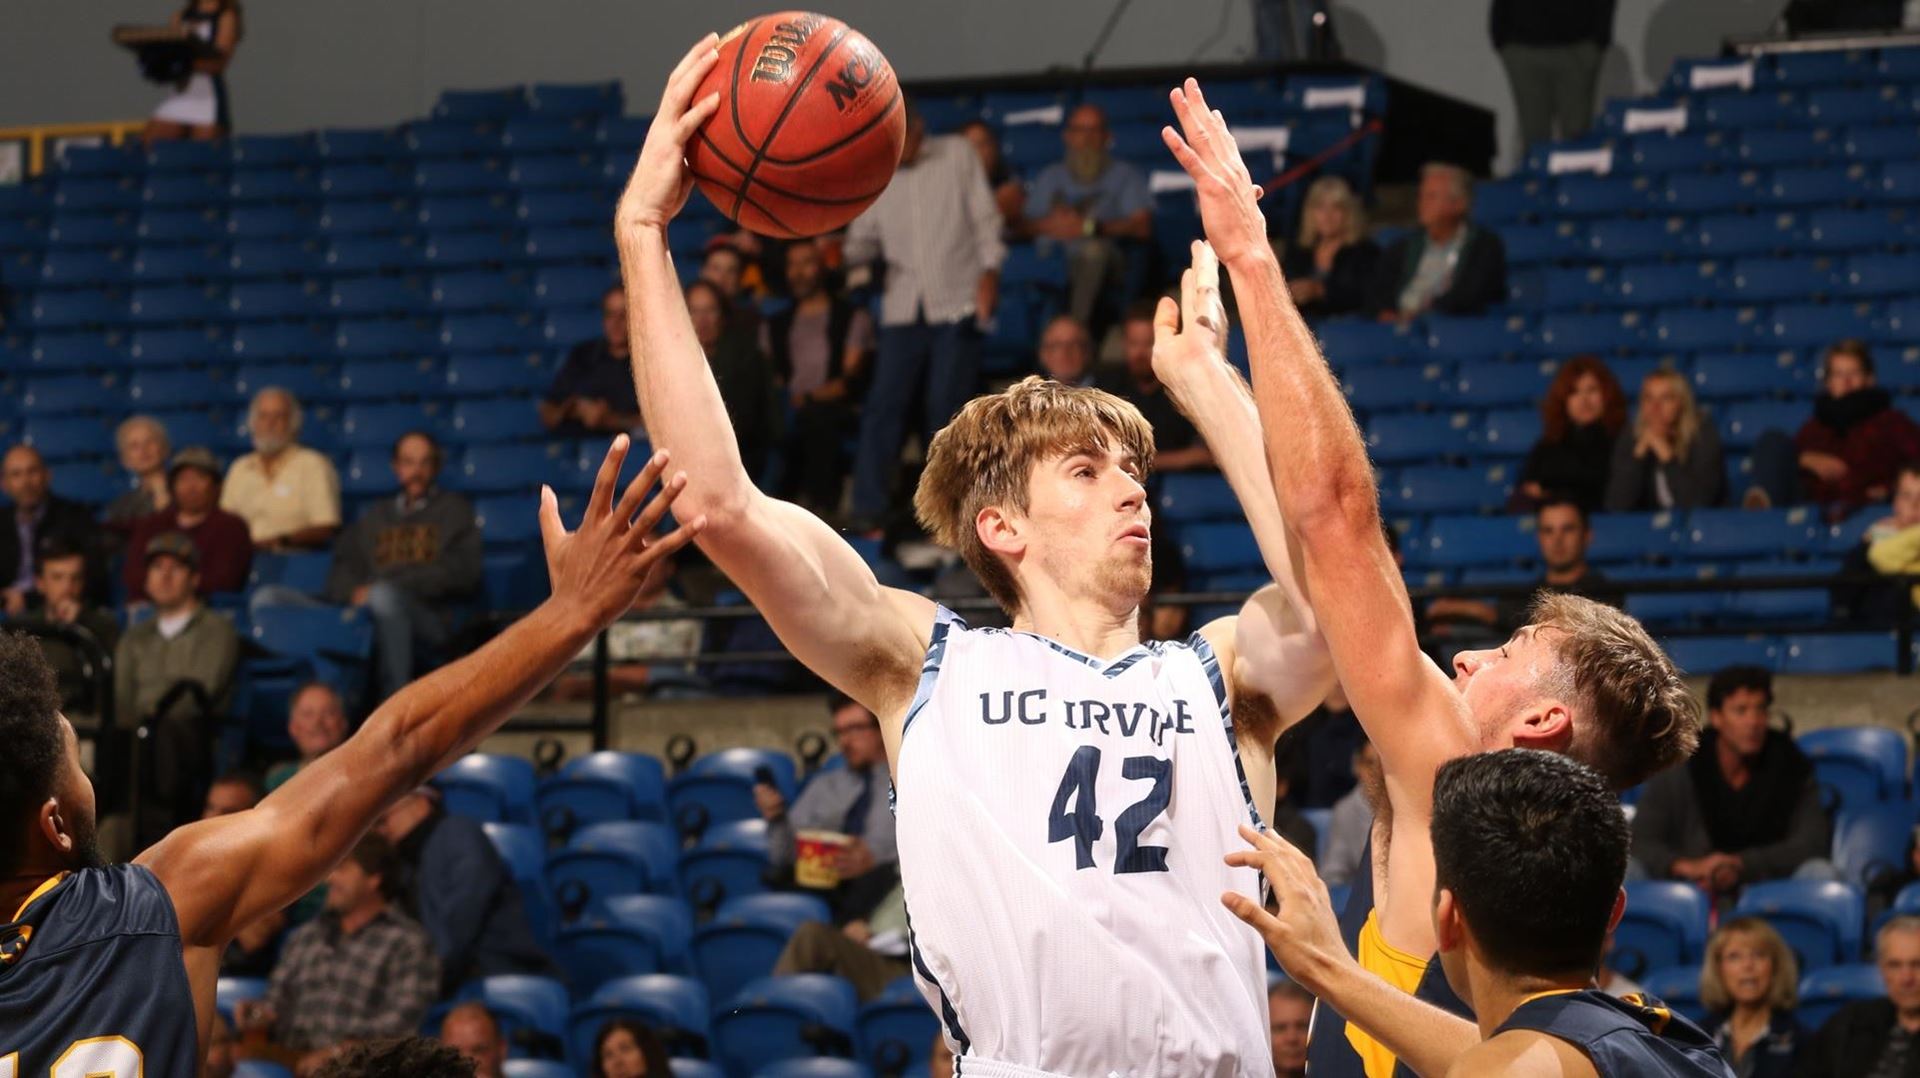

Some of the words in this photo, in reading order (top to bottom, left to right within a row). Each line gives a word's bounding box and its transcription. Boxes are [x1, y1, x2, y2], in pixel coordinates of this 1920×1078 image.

[751, 12, 828, 82] Wil
[825, 46, 882, 112] NC
[979, 688, 1047, 726] UC
[1047, 745, 1174, 875] 42
